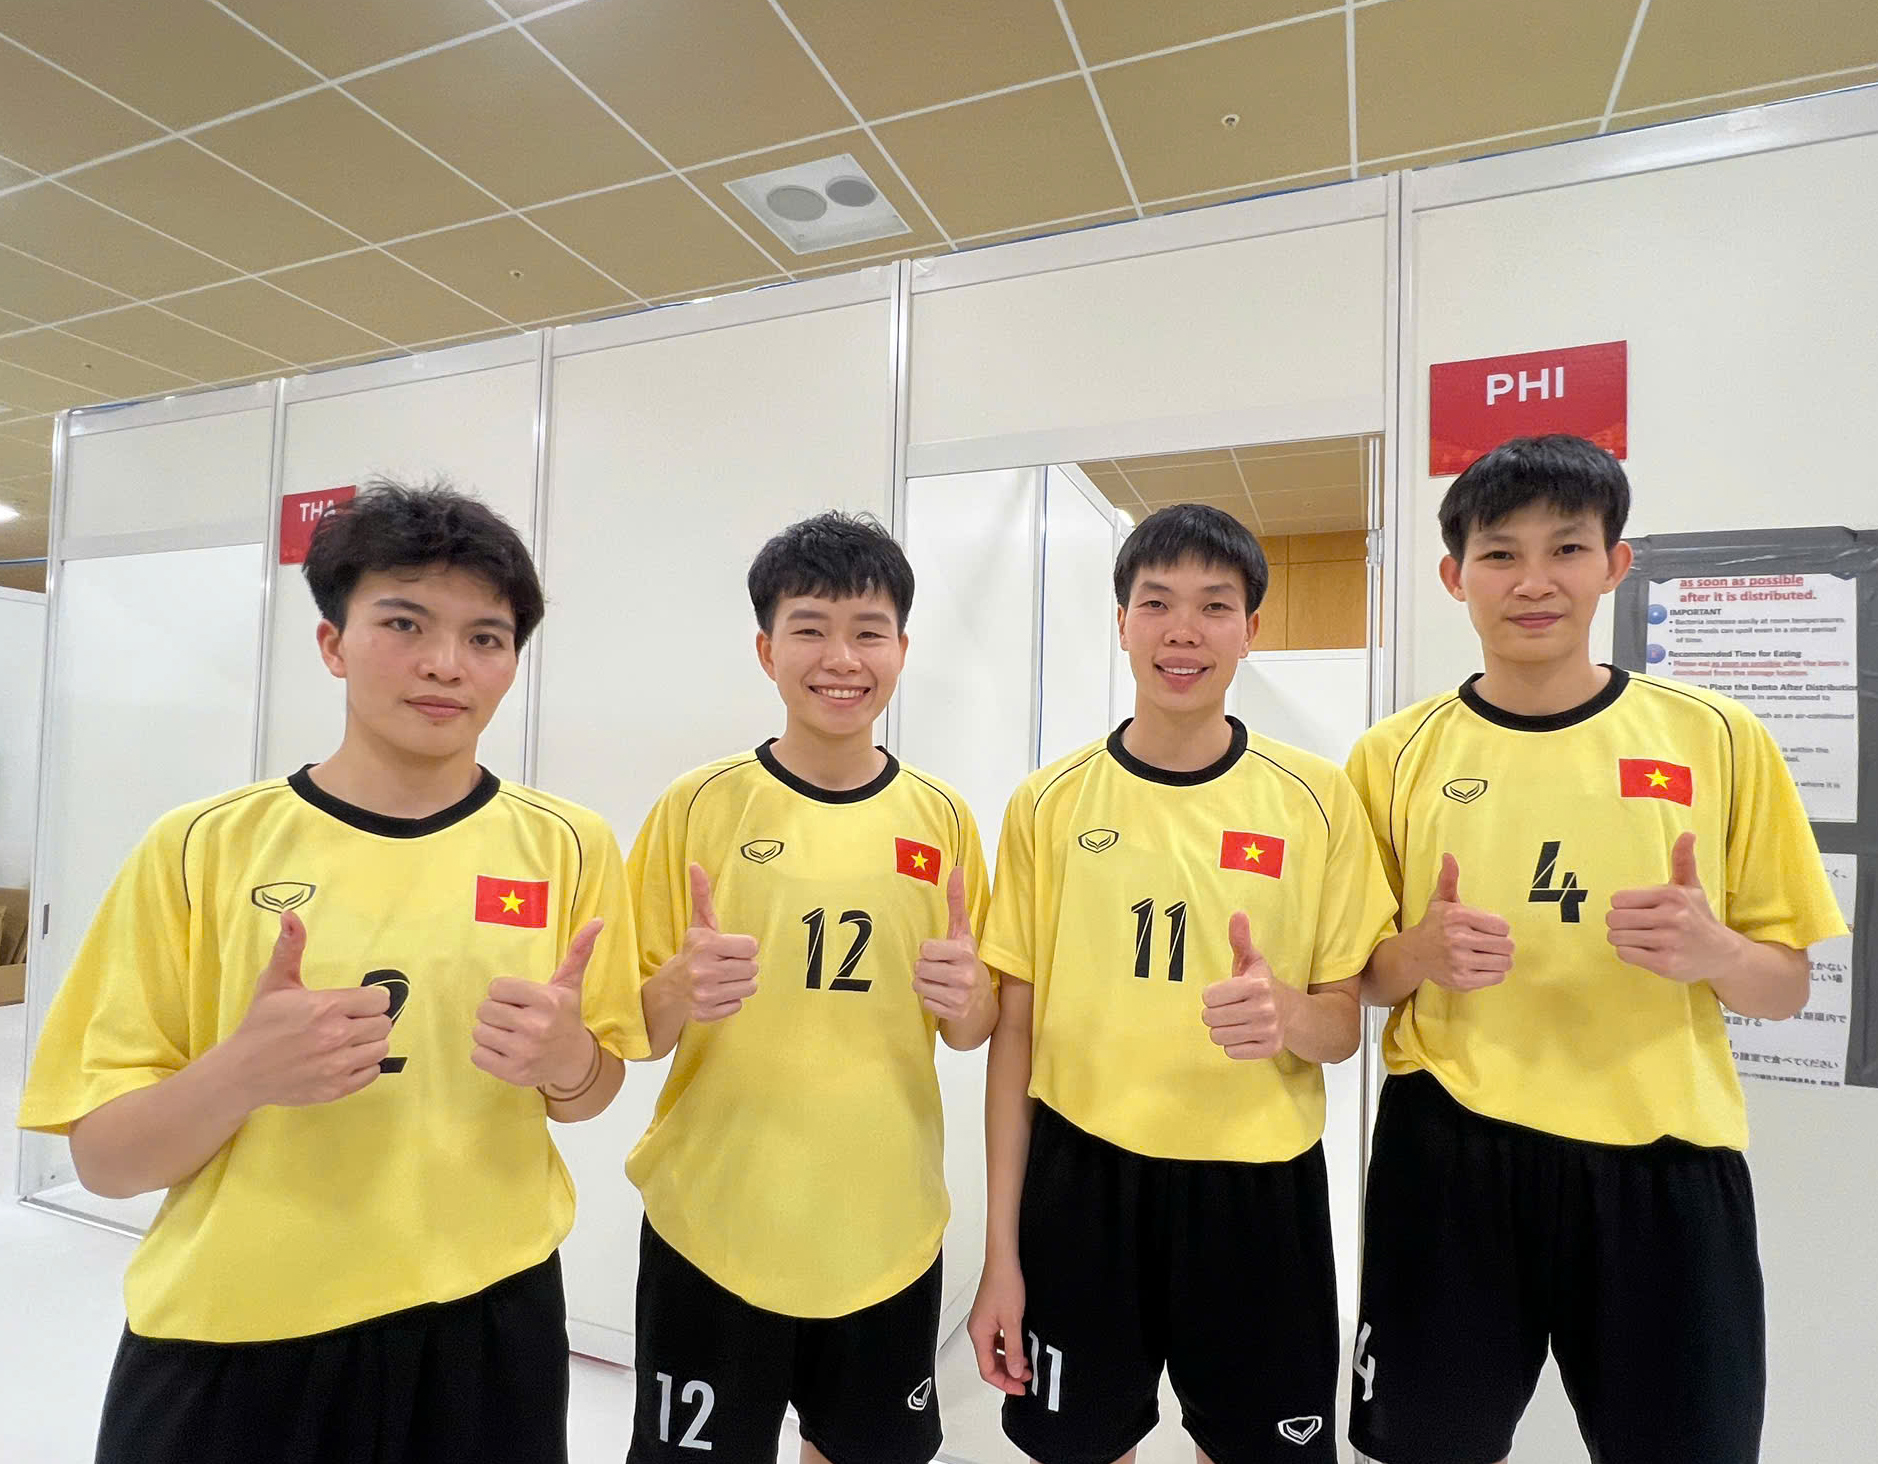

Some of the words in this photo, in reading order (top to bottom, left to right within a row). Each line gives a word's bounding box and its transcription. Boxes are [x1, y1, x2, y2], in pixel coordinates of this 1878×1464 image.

[1486, 366, 1564, 406] PHI
[1680, 579, 1694, 588] as
[1697, 579, 1728, 588] soon
[1732, 578, 1746, 587] as
[1749, 574, 1804, 587] possible
[1680, 592, 1710, 602] after
[1714, 592, 1723, 601] it
[1726, 592, 1738, 601] is
[1740, 589, 1817, 601] distributed.
[1669, 608, 1722, 616] IMPORTANT
[1773, 650, 1802, 658] Eating
[1527, 840, 1588, 923] 4
[801, 907, 873, 993] 12
[1131, 897, 1187, 983] 11
[656, 1371, 716, 1451] 12
